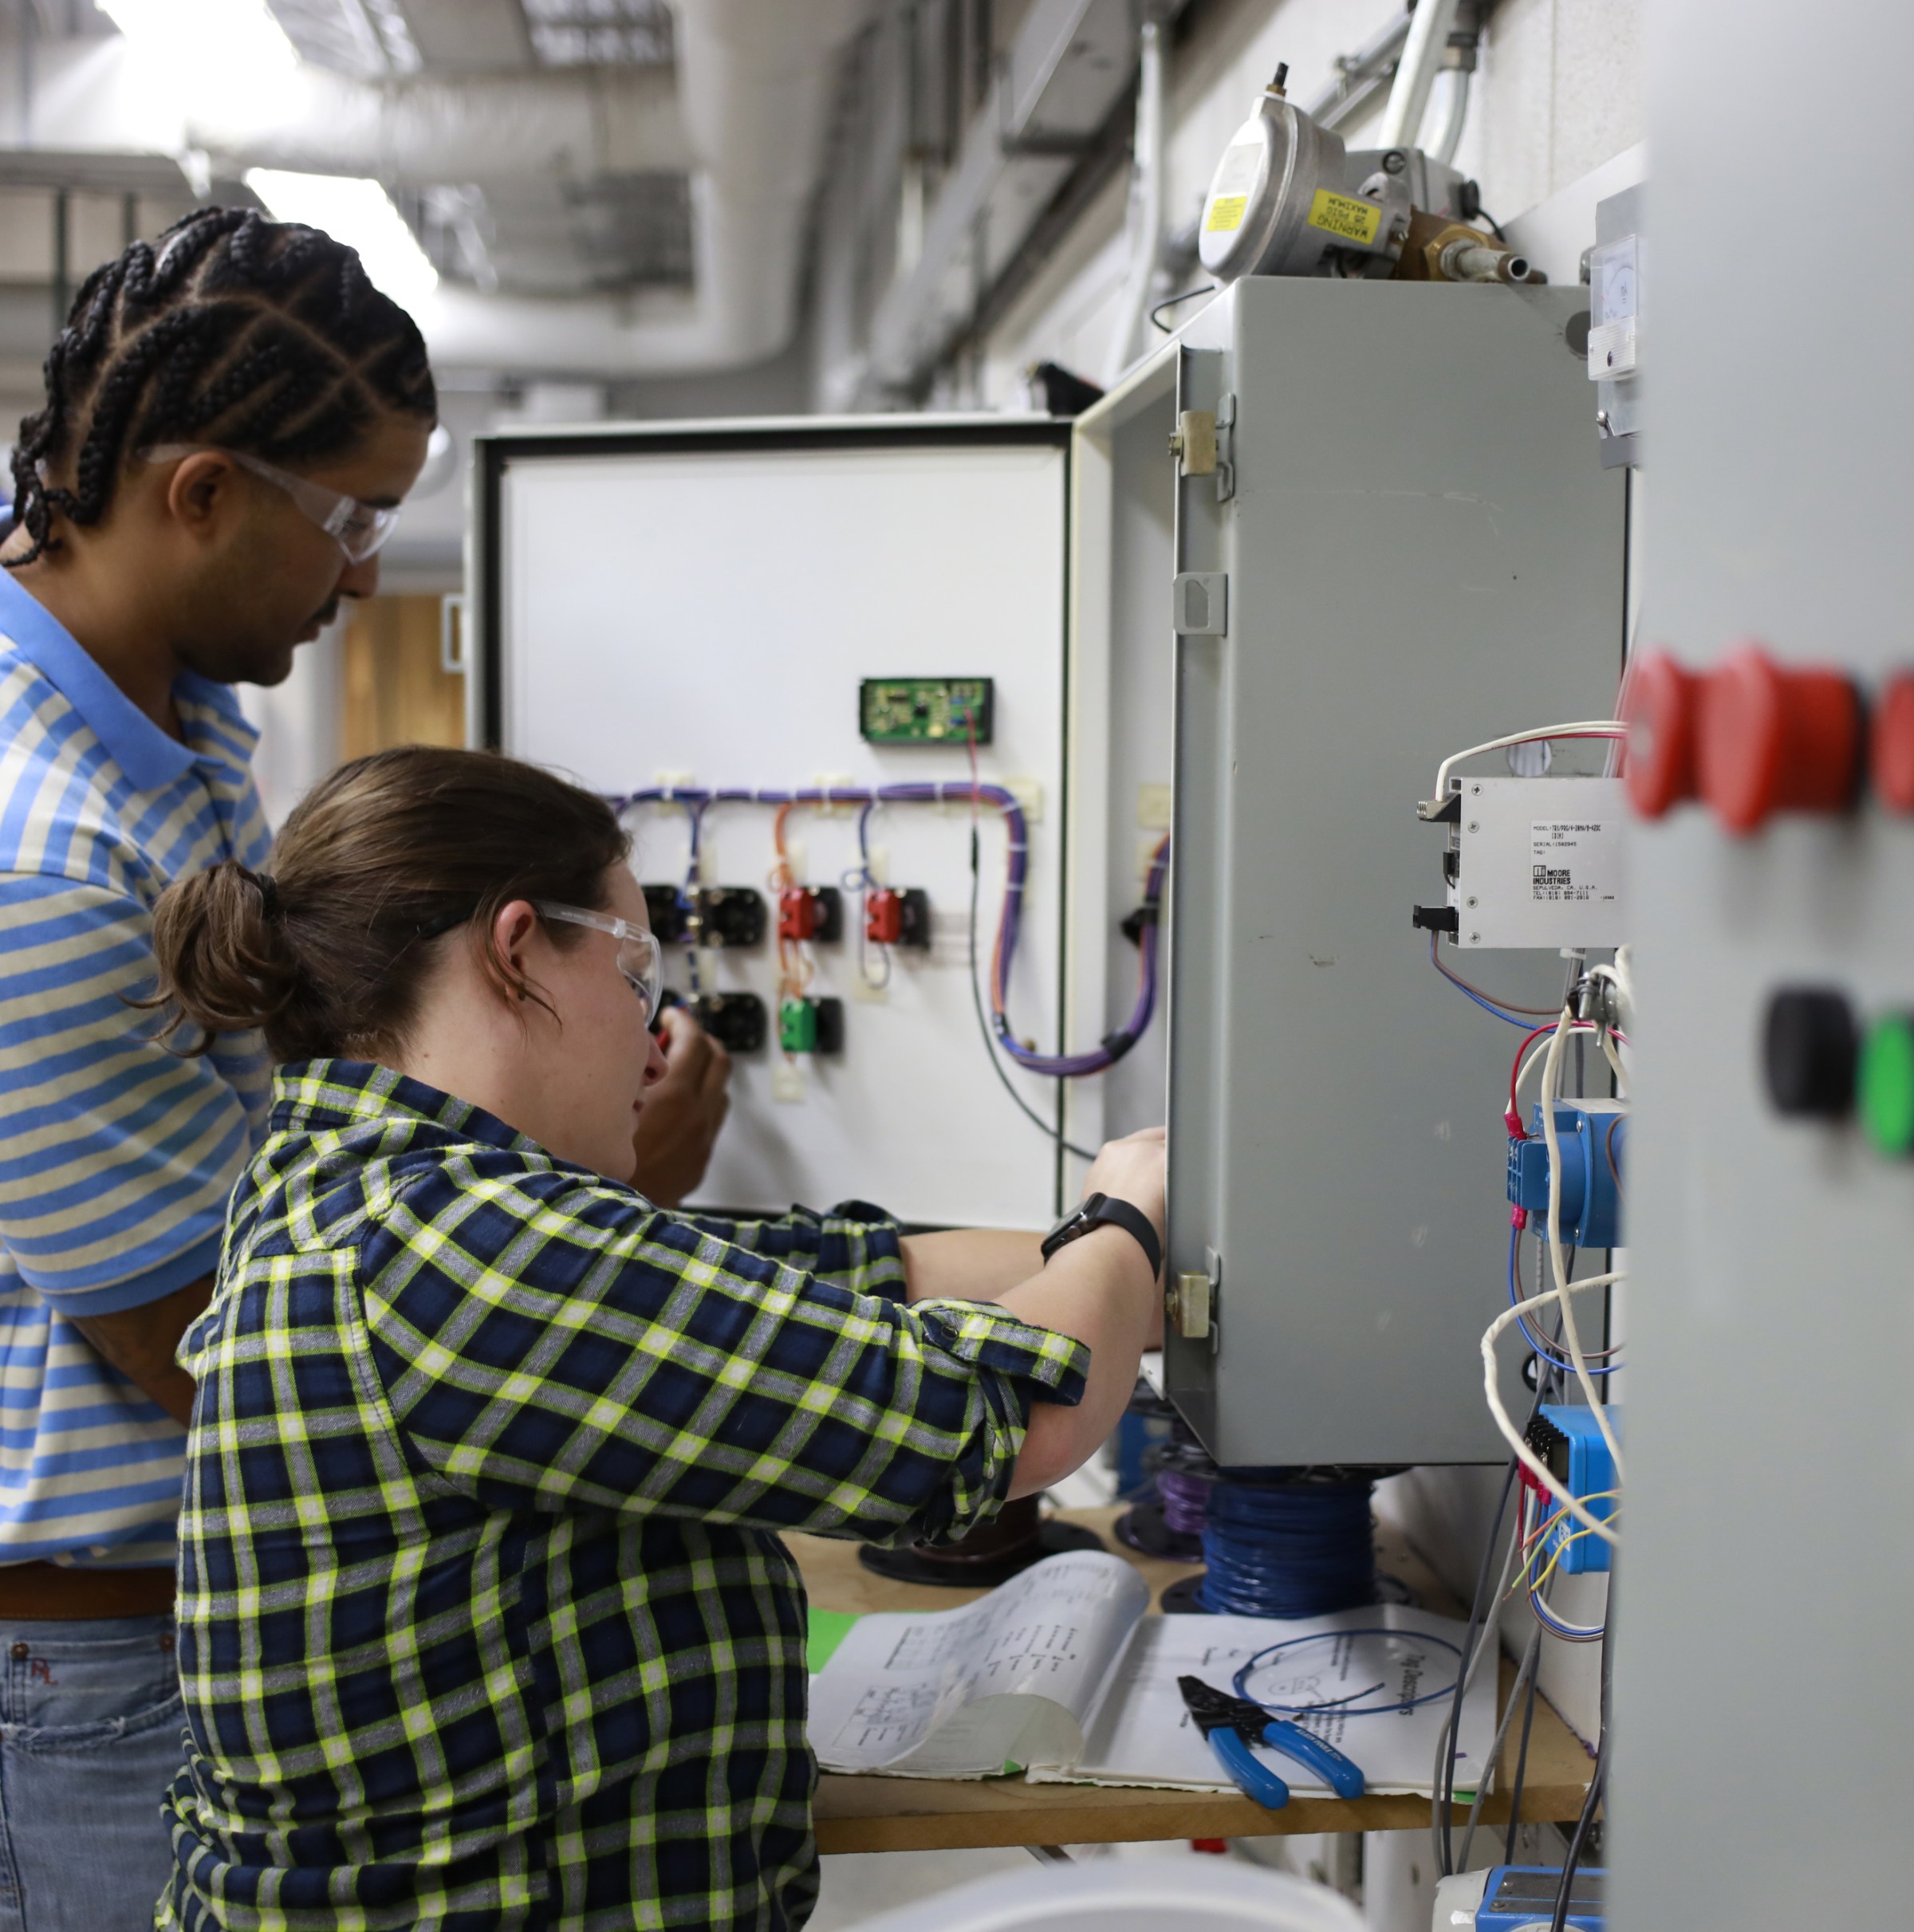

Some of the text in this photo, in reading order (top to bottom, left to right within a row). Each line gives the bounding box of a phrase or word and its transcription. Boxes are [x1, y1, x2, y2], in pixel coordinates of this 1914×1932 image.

[1328, 197, 1369, 214] MAXIMUM
[1317, 215, 1369, 238] WARNING
[1397, 1655, 1426, 1715] Tag Descriprs
